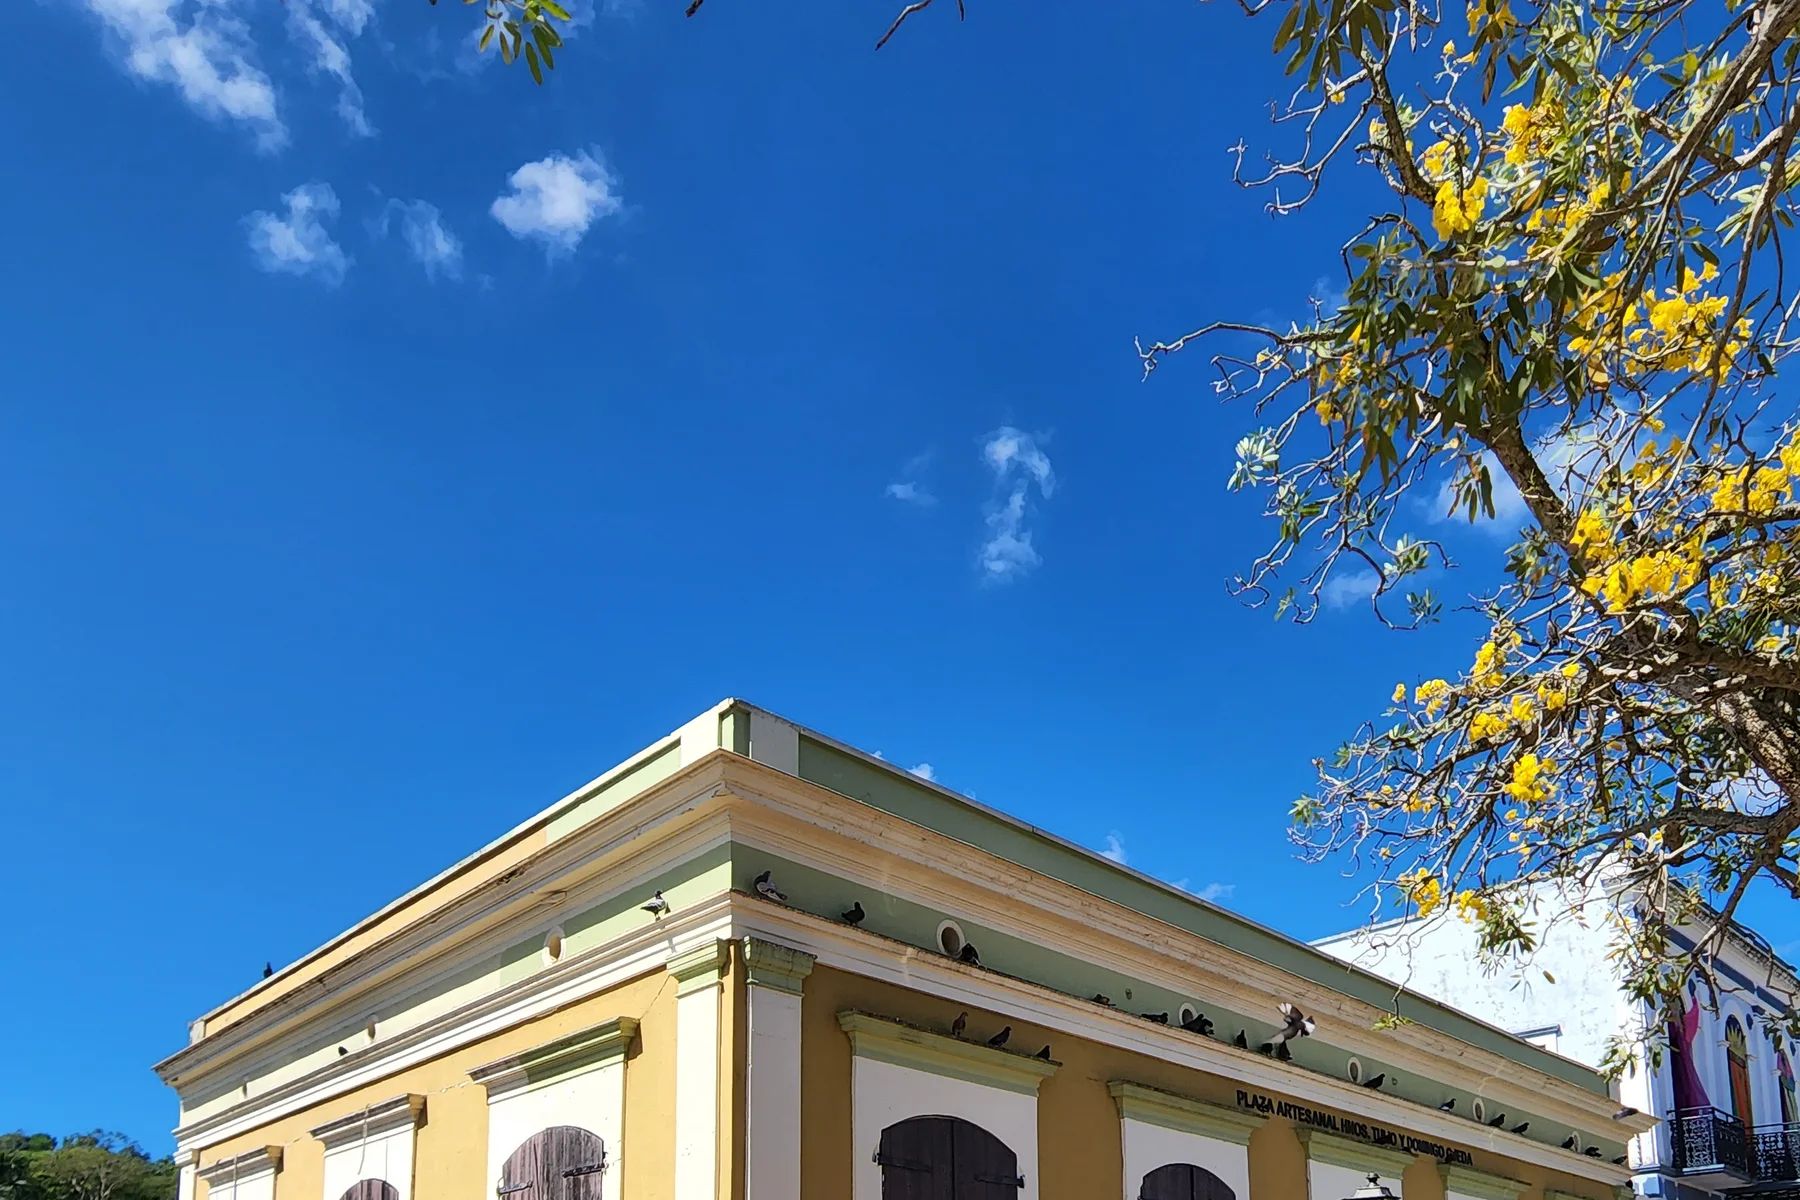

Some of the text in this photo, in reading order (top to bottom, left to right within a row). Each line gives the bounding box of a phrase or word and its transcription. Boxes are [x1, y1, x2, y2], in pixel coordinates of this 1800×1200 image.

[1236, 1089, 1275, 1114] PLAZA
[1276, 1100, 1340, 1131] ARTESANAL
[1398, 1133, 1406, 1148] Y
